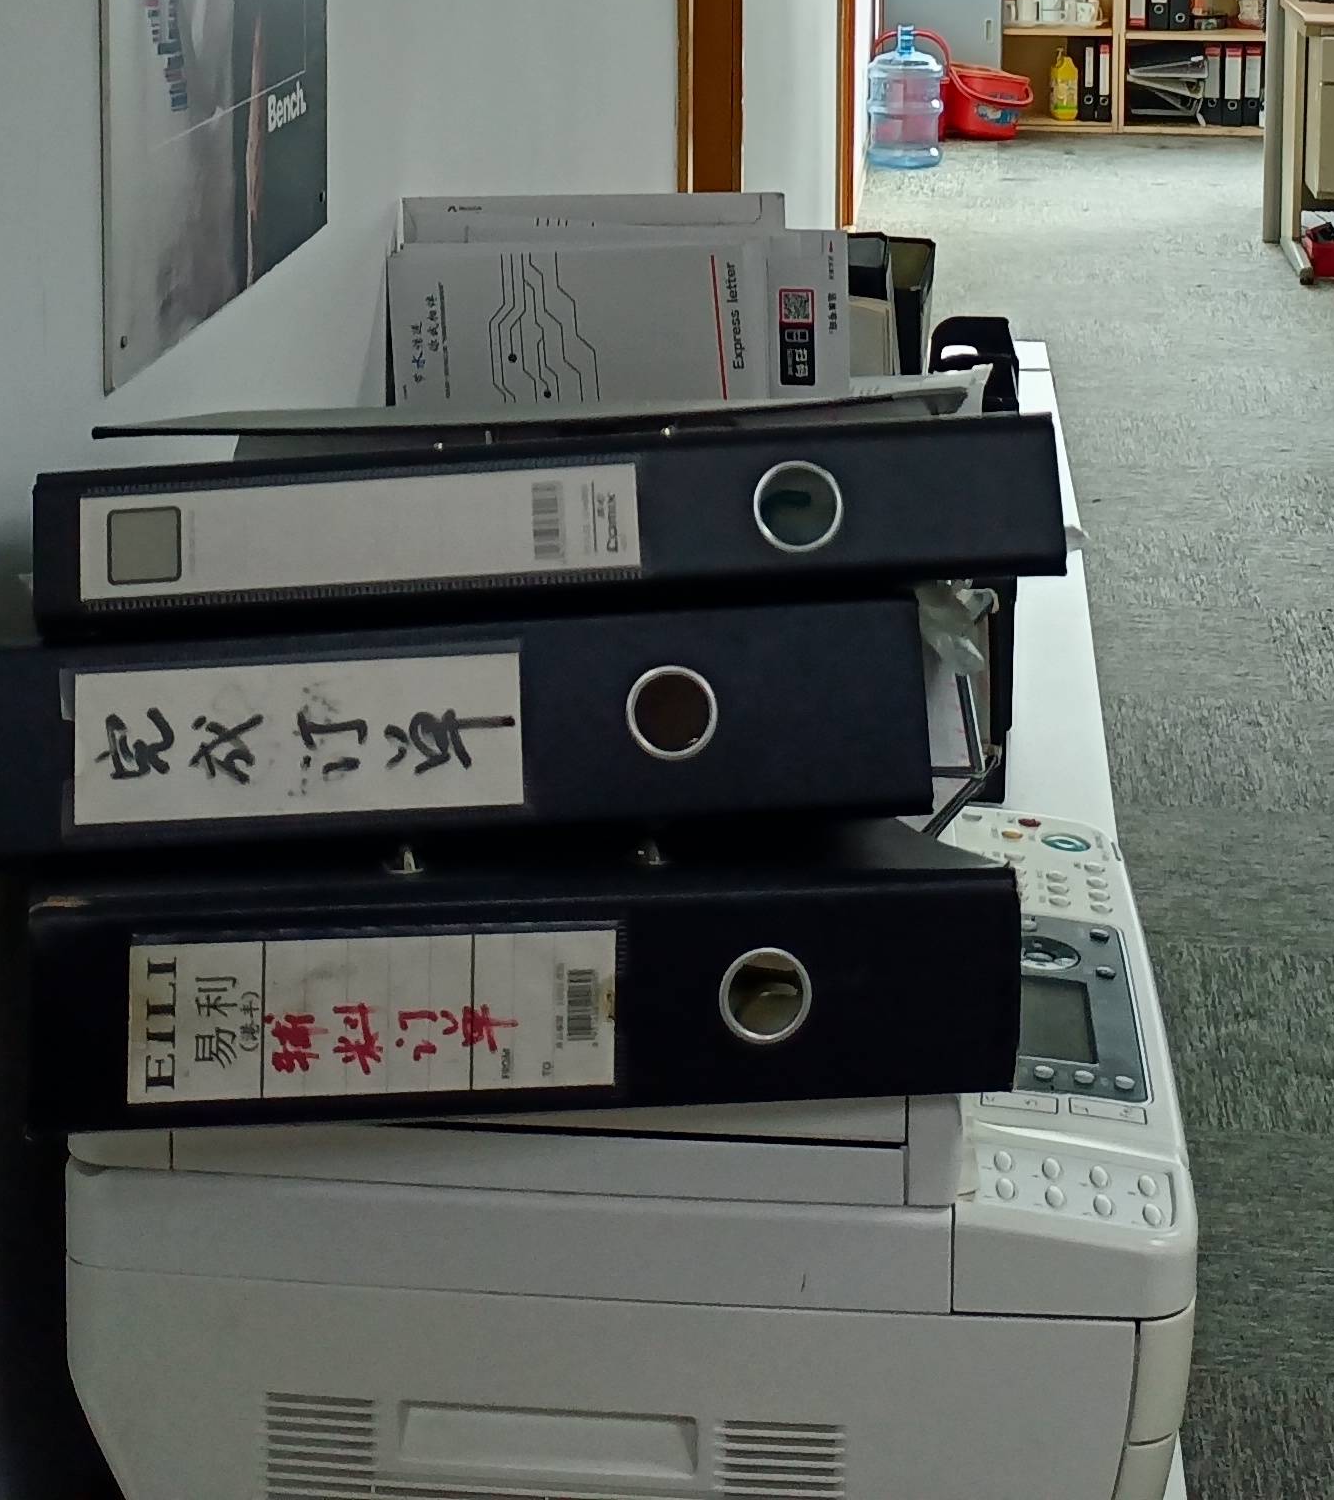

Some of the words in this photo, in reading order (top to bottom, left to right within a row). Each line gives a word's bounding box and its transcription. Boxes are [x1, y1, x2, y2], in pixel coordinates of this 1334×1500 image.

[725, 262, 739, 304] letter
[729, 309, 746, 370] Express
[94, 707, 516, 784] 完成订单
[144, 956, 177, 1094] EILI
[193, 975, 238, 1069] 易利
[263, 1001, 519, 1075] 辅料订单
[501, 1047, 511, 1080] FROM
[542, 1061, 552, 1077] TO
